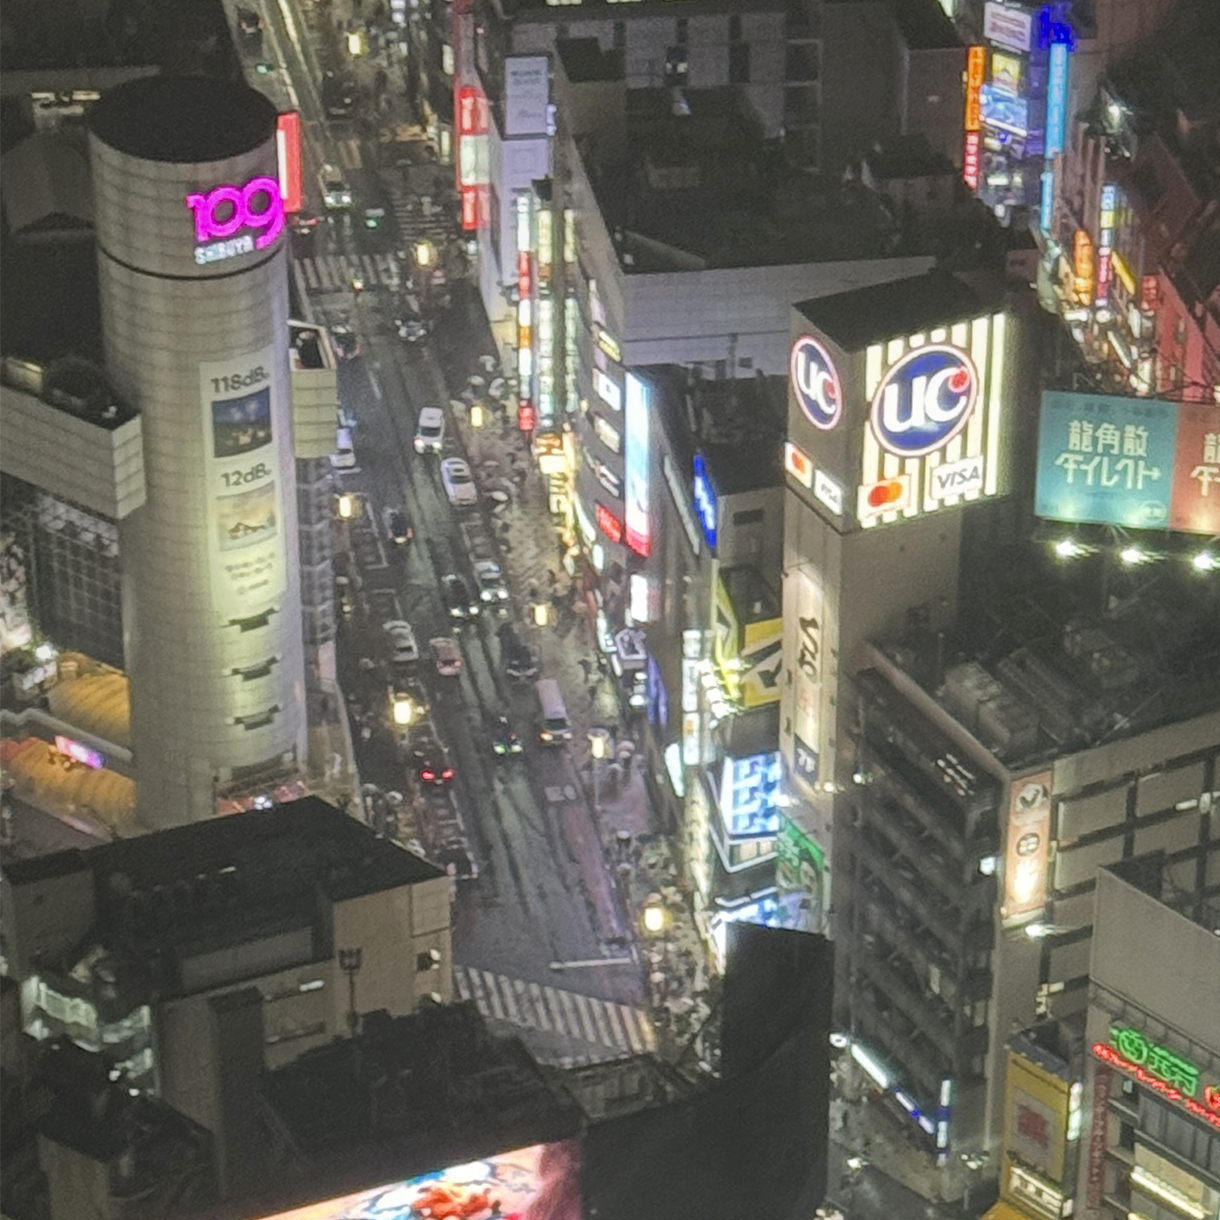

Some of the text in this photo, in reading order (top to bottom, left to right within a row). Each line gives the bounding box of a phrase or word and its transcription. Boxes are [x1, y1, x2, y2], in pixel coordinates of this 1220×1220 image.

[186, 177, 284, 250] 109
[1067, 420, 1149, 457] 龍角散
[937, 465, 980, 491] VISA
[1055, 453, 1162, 490] ダイレクト
